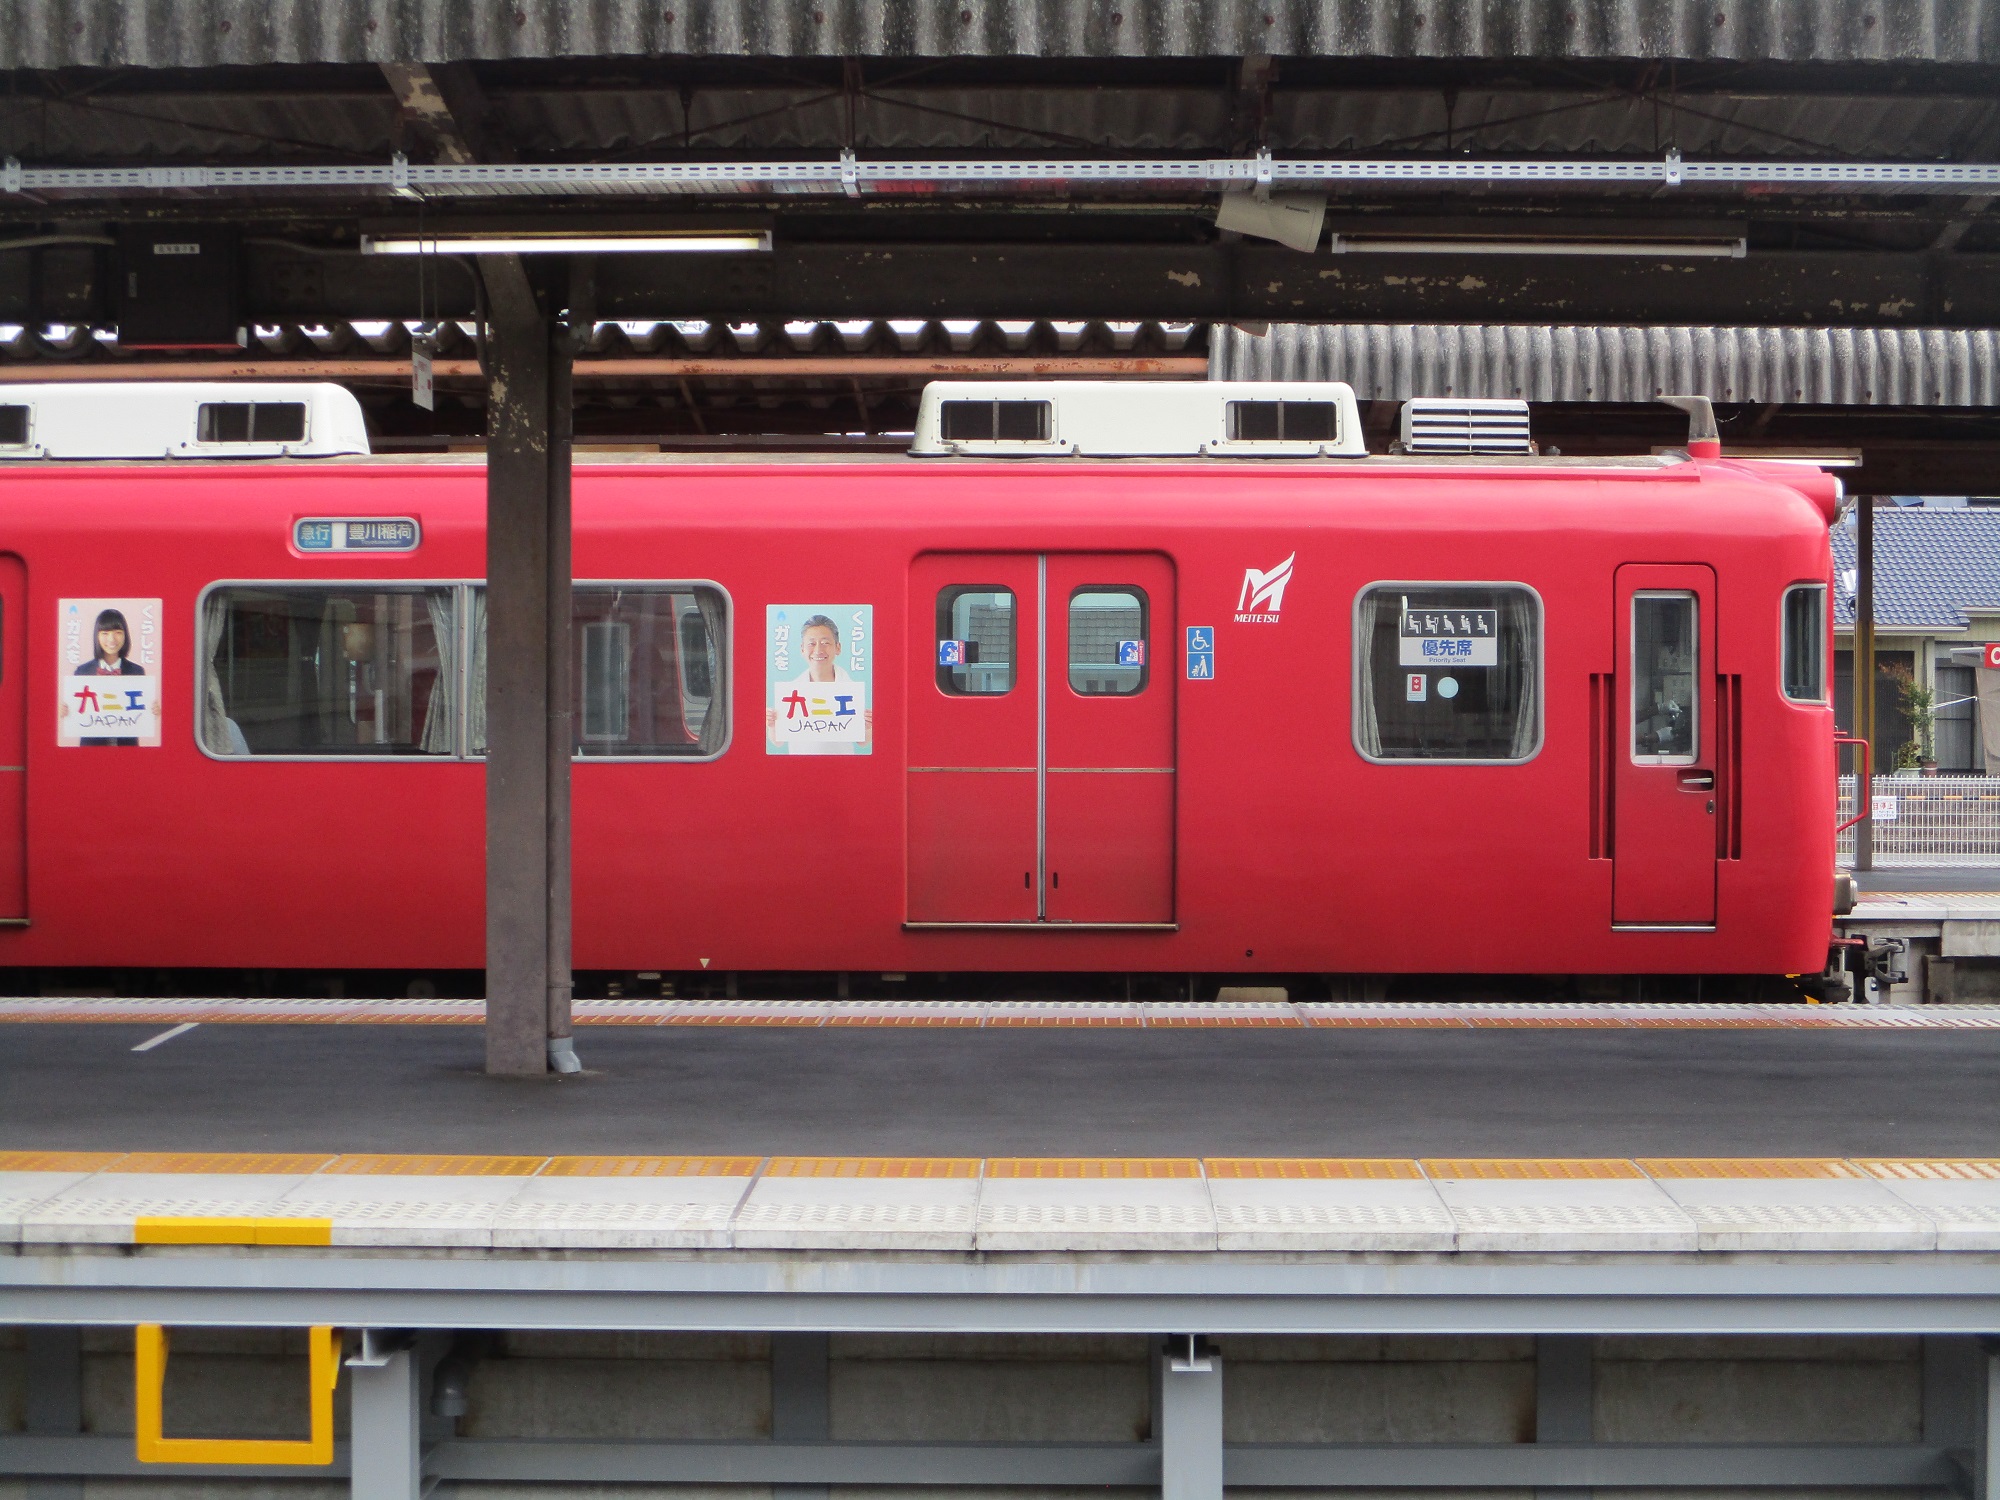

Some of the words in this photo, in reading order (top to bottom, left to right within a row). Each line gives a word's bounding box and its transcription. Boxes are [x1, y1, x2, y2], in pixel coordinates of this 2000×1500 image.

[301, 524, 330, 540] 急行
[348, 523, 412, 540] 豊川稲荷
[1233, 613, 1280, 623] MEITETSU
[140, 604, 154, 664] くらしに
[850, 610, 865, 671] くらしに
[774, 625, 790, 671] ガスを
[1422, 640, 1472, 656] 優先席
[782, 690, 856, 719] カニエ
[80, 713, 142, 728] JAPAN
[788, 718, 852, 733] JAPAN
